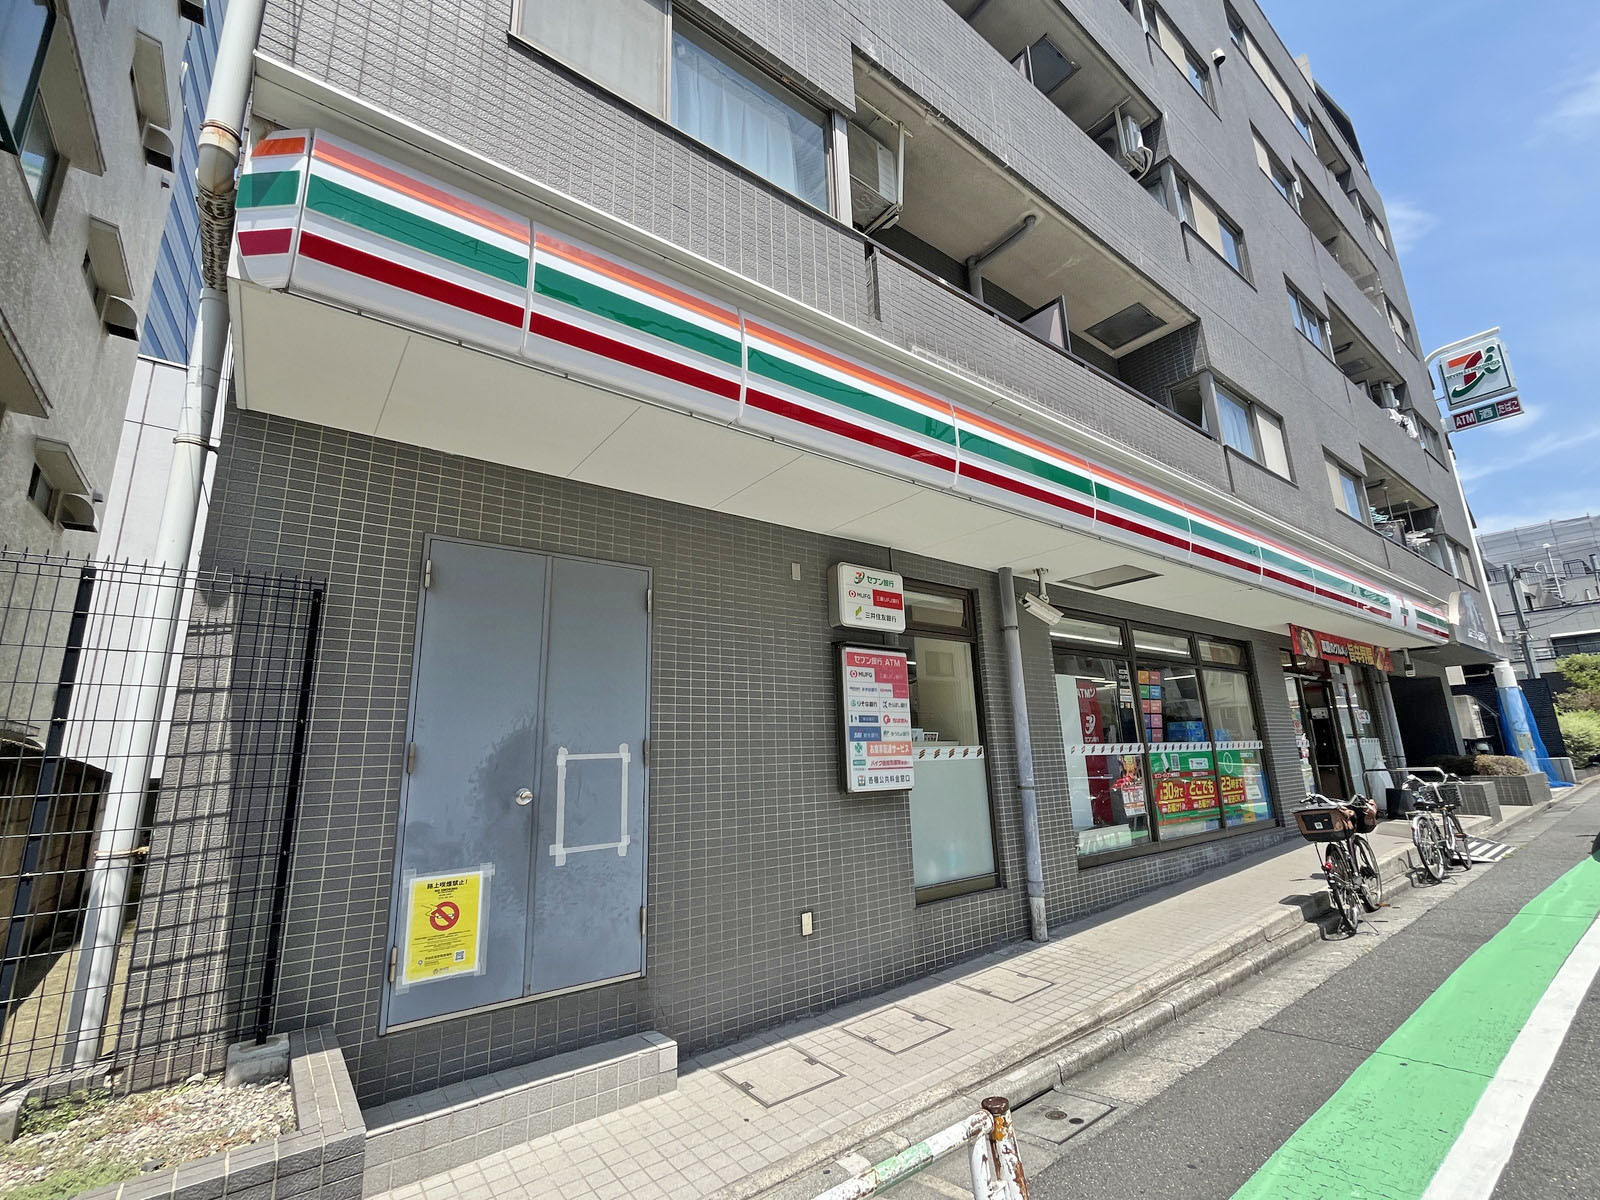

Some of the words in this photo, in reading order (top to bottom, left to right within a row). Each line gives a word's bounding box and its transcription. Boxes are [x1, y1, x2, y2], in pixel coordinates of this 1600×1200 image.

[1497, 400, 1520, 414] たばこ
[1455, 412, 1475, 427] ATM
[1479, 407, 1494, 420] 酒
[866, 576, 894, 588] セブン銀行
[865, 611, 897, 623] 三井住友銀行
[854, 655, 882, 665] セブン銀行
[885, 658, 901, 667] ATM
[857, 700, 878, 708] りそな銀行
[868, 774, 911, 785] 各種公共料金窓口
[1220, 776, 1244, 792] 23時まで
[1189, 778, 1215, 795] どこでも
